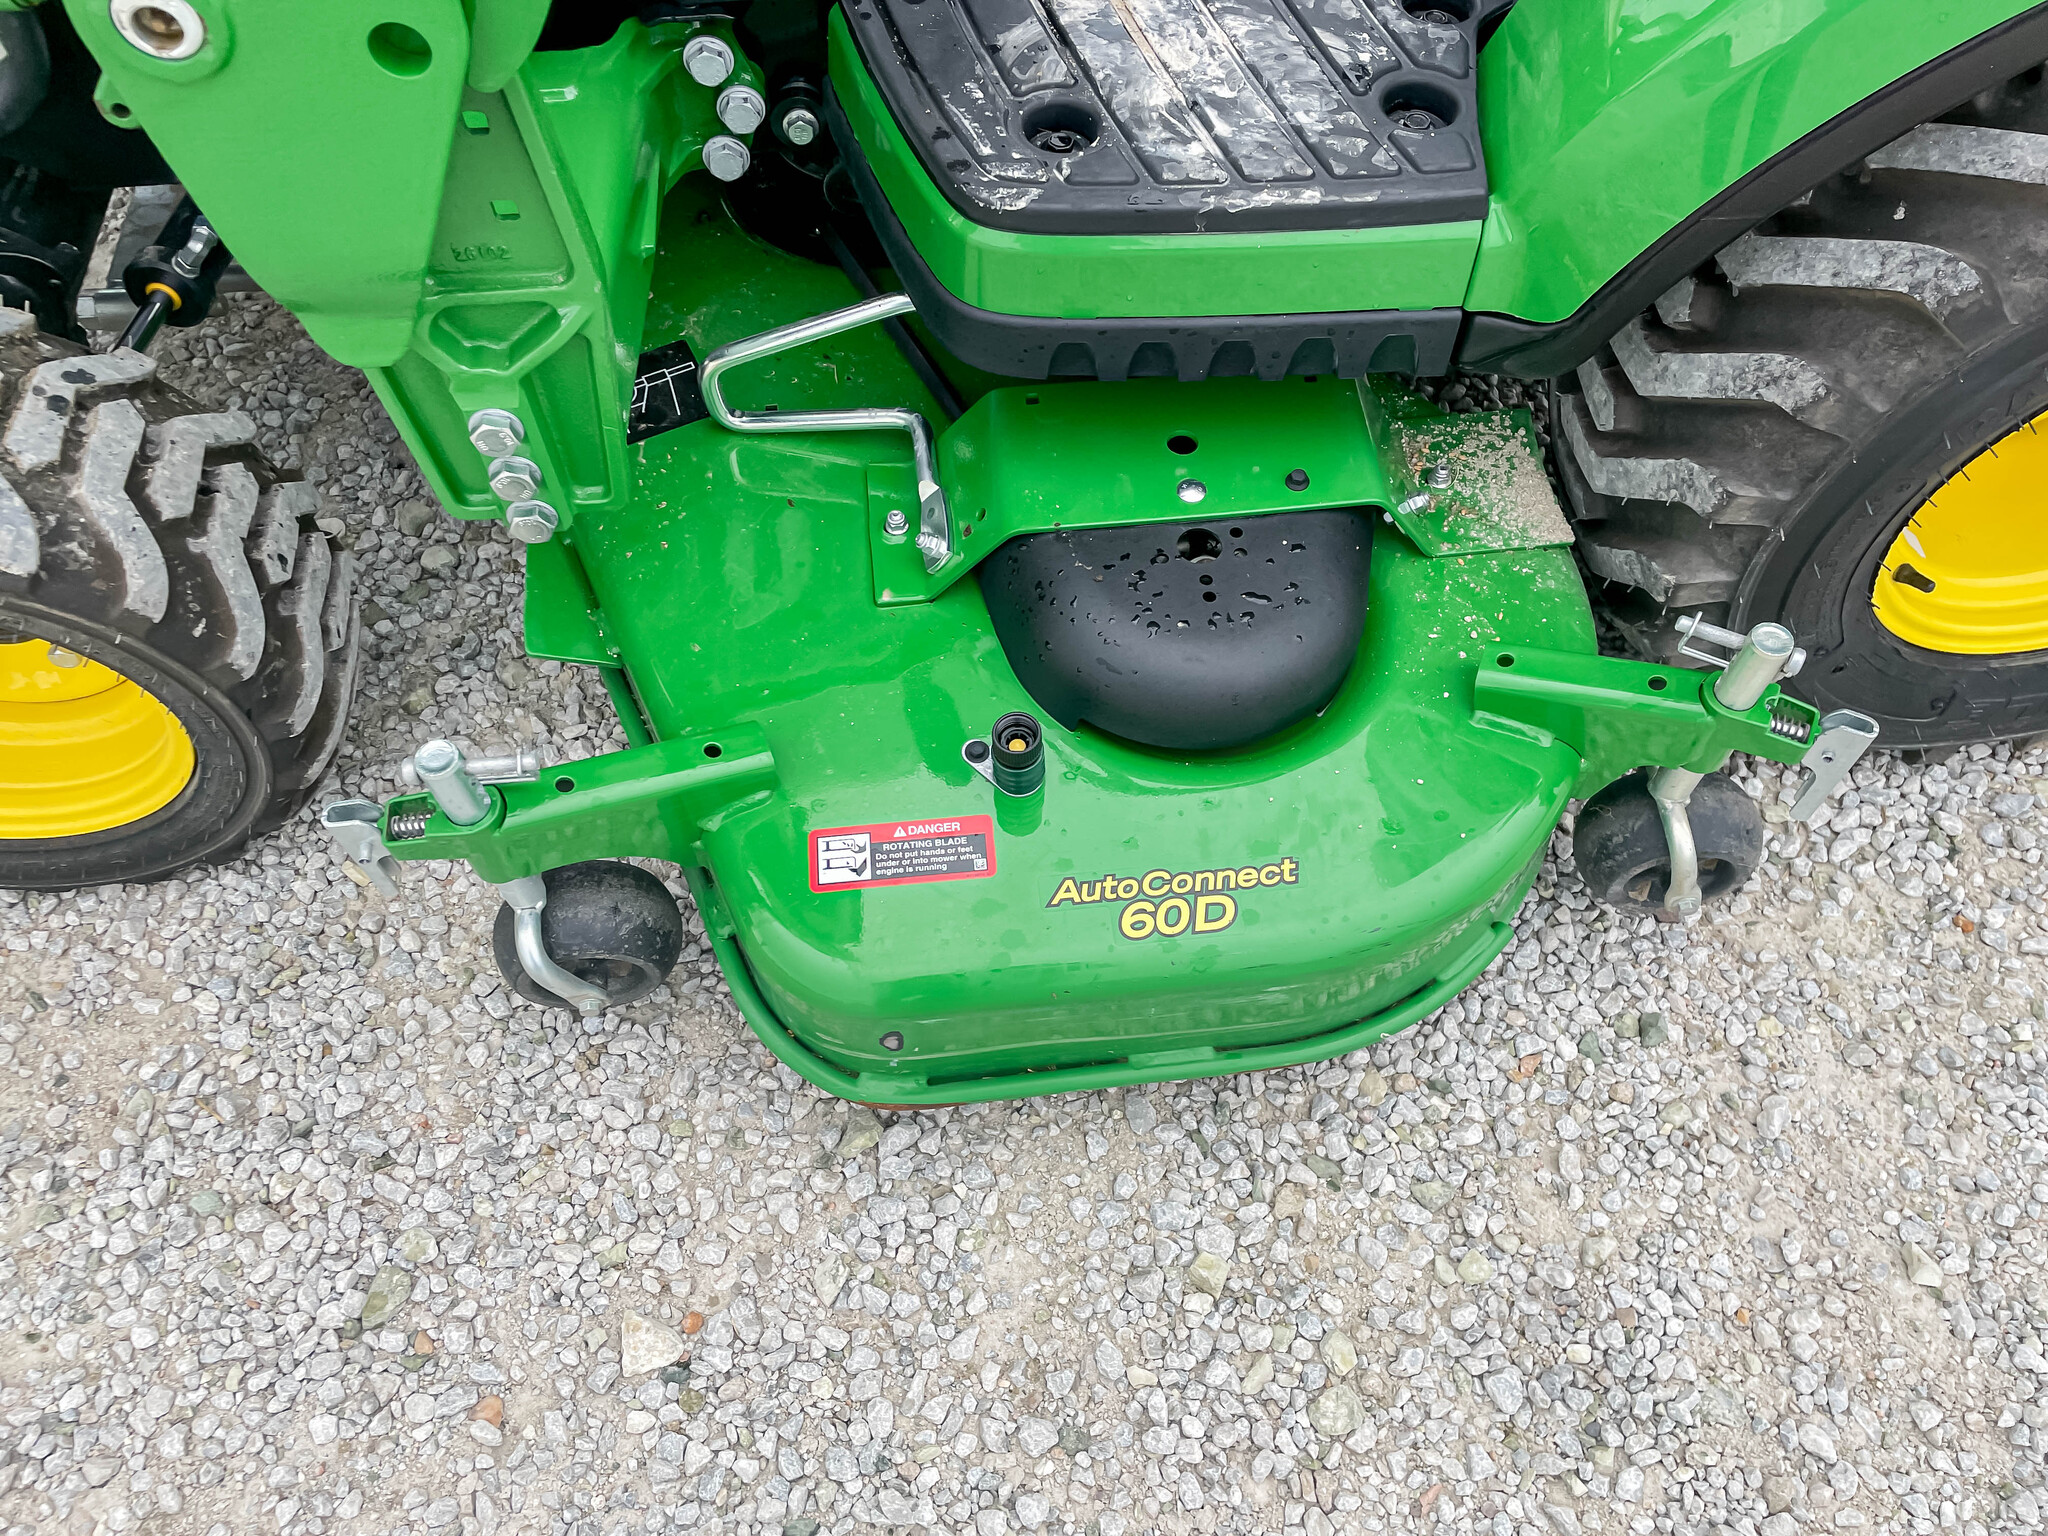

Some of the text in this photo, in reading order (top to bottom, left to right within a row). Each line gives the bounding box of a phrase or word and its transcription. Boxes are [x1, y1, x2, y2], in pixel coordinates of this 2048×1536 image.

[908, 822, 960, 835] DANGER
[883, 837, 967, 851] ROTATING BLADE
[904, 850, 918, 859] put
[920, 847, 945, 856] hands
[912, 857, 928, 865] into
[876, 867, 904, 876] engine
[915, 863, 948, 873] running
[1045, 856, 1299, 908] AutoConnect
[1118, 893, 1238, 941] 60D
